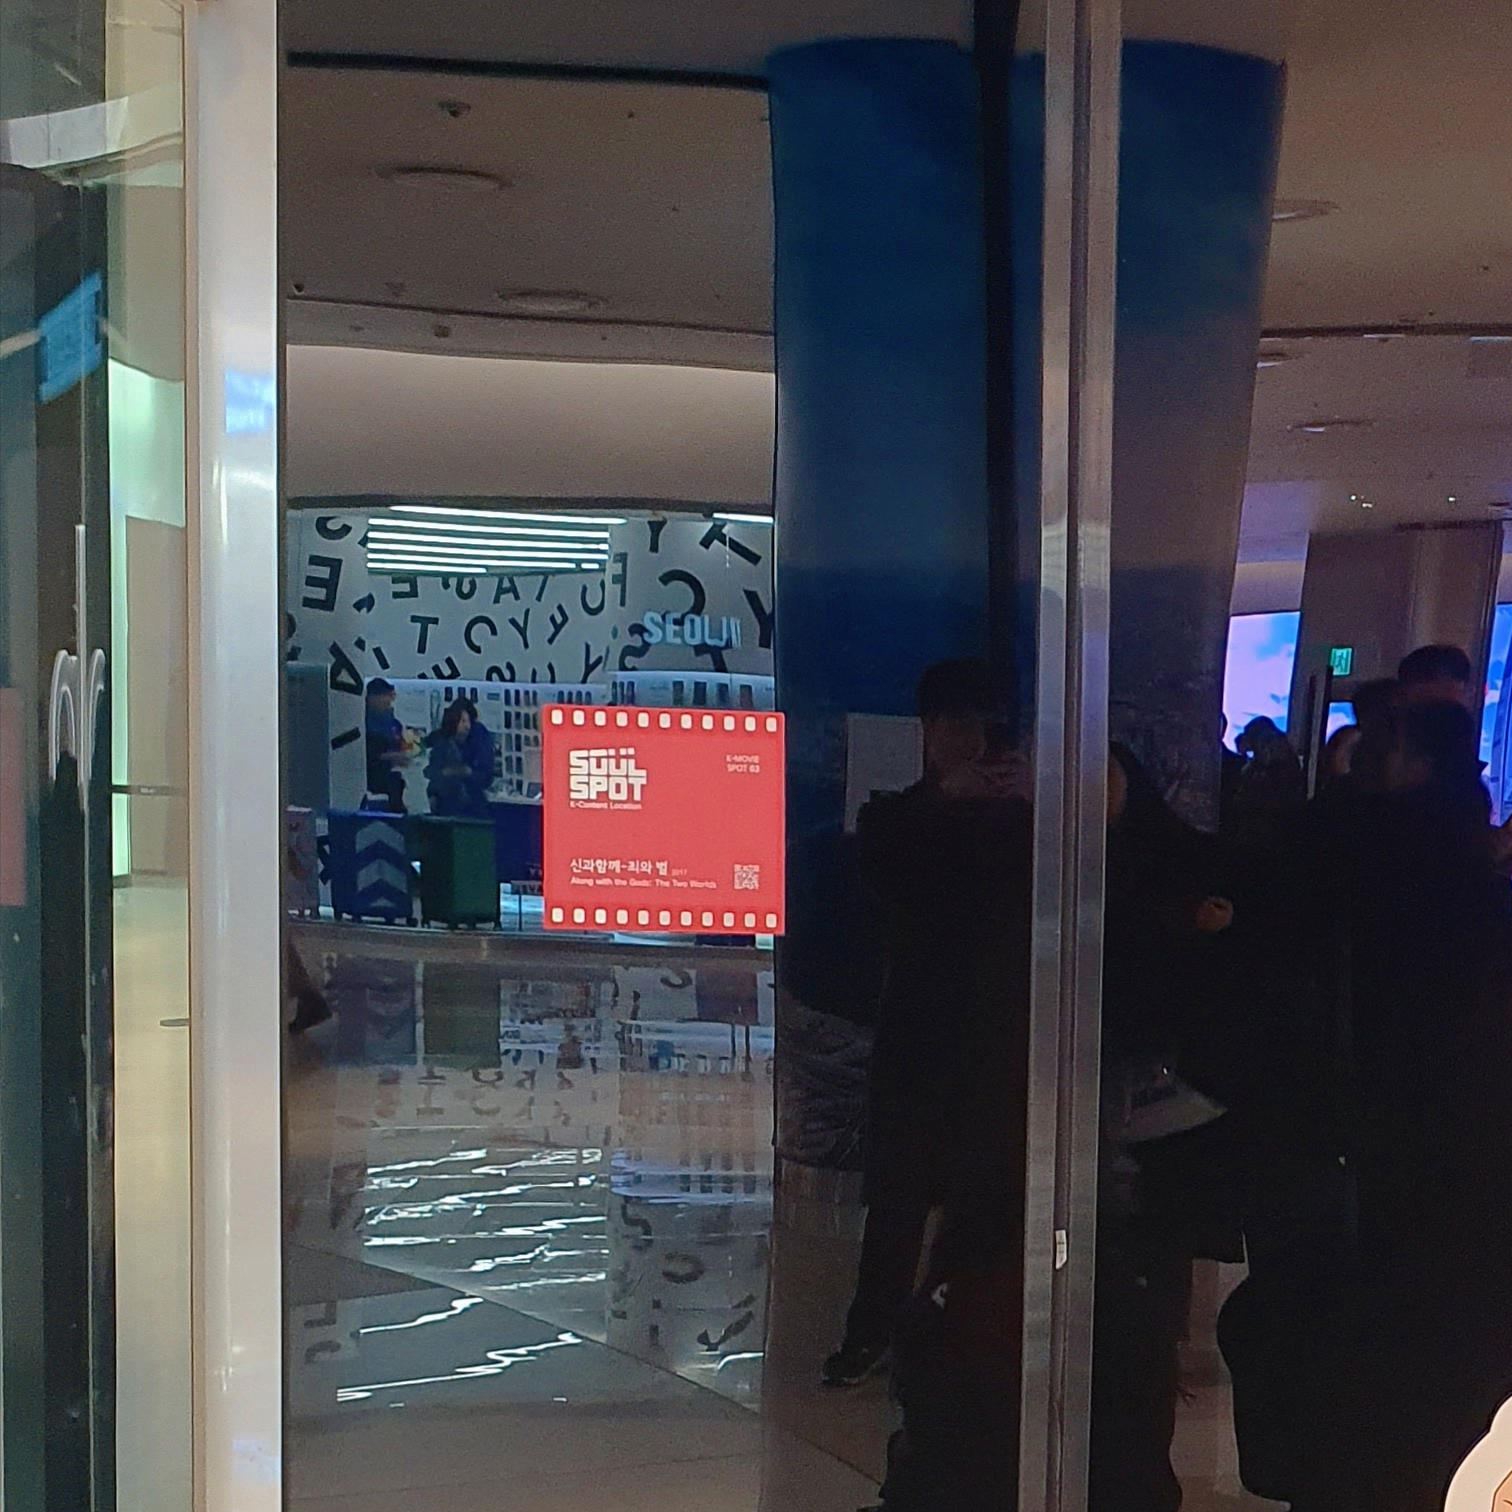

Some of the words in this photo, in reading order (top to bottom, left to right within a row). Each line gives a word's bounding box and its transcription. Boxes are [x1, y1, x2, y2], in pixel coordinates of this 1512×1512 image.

[727, 764, 748, 773] SPOT
[569, 775, 647, 802] SPOT
[570, 801, 608, 810] K-Content
[610, 803, 642, 811] Location
[656, 860, 668, 876] 벌
[570, 876, 594, 887] Along
[596, 877, 613, 886] with
[615, 878, 628, 886] the
[655, 879, 671, 888] The
[673, 880, 688, 888] Two
